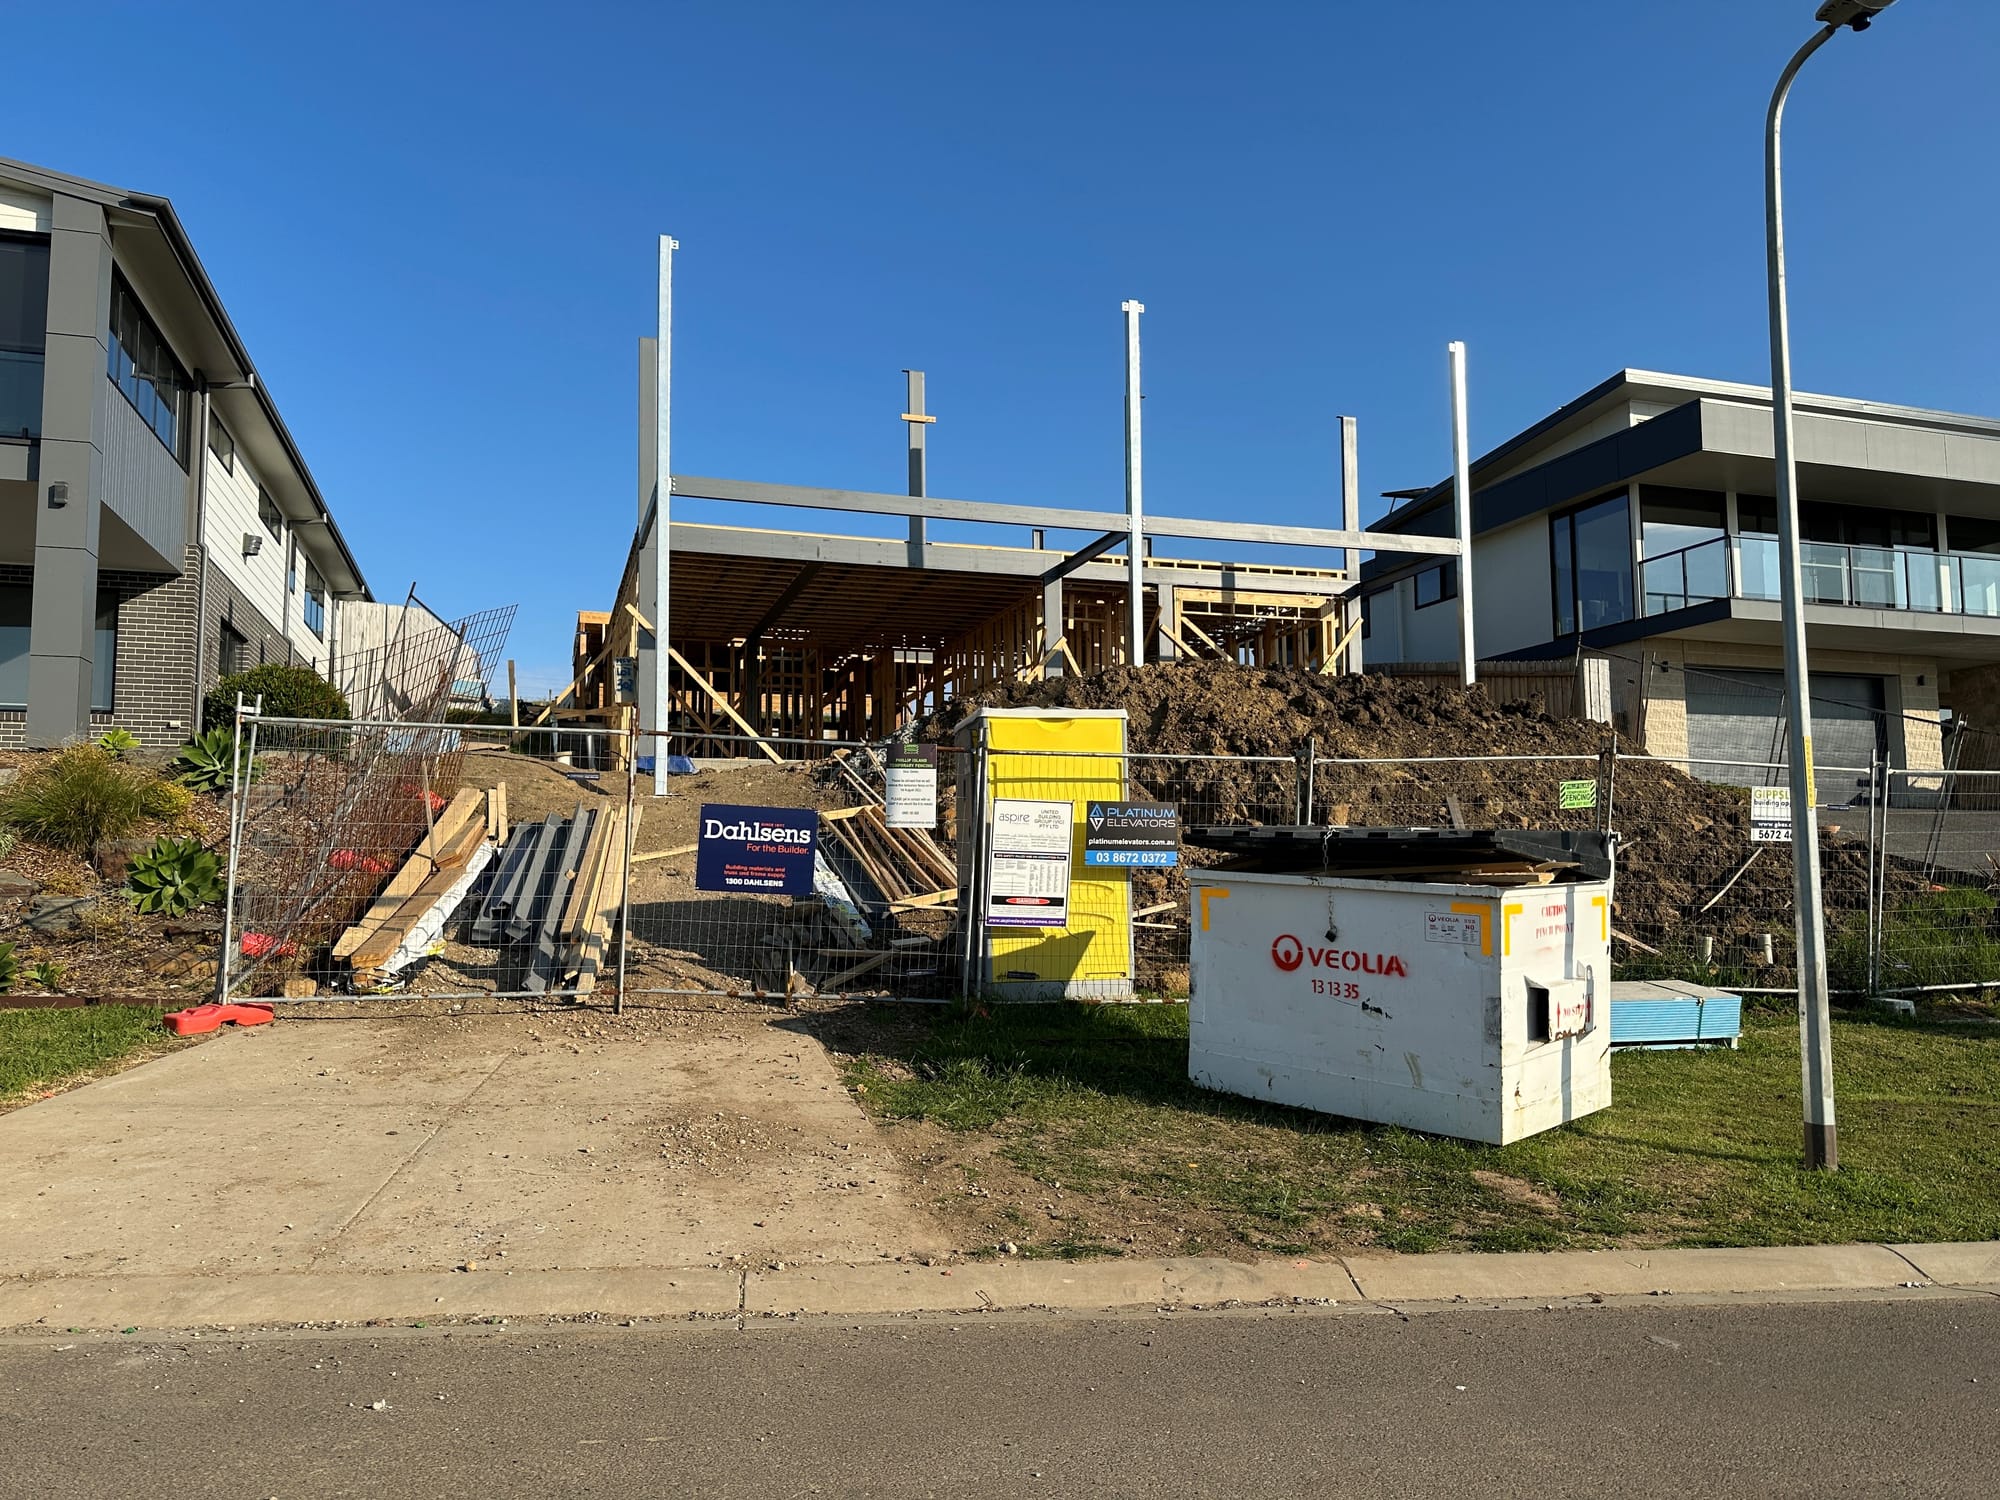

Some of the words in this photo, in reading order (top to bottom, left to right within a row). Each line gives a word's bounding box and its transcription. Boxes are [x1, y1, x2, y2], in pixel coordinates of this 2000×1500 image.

[1566, 793, 1591, 801] FENCING
[1754, 789, 1790, 800] GIPPSL
[1754, 799, 1780, 808] building
[1107, 807, 1176, 818] PLATINUM
[998, 813, 1030, 824] aspire
[1107, 818, 1176, 828] ELEVATORS
[704, 819, 811, 844] Dahlsens
[1759, 830, 1781, 840] 5672
[1088, 838, 1175, 846] platinumelevators.com.au
[746, 843, 760, 852] For
[762, 844, 777, 853] the
[777, 845, 810, 855] Builder.
[1096, 853, 1110, 863] 03
[1113, 853, 1139, 863] 8672
[1141, 853, 1167, 863] 0372
[743, 878, 784, 887] DAHLSENS
[1541, 903, 1569, 917] CAUTION
[1307, 946, 1406, 978] VEOLIA
[1311, 979, 1325, 994] 13
[1327, 981, 1341, 997] 13
[1343, 983, 1360, 999] 35
